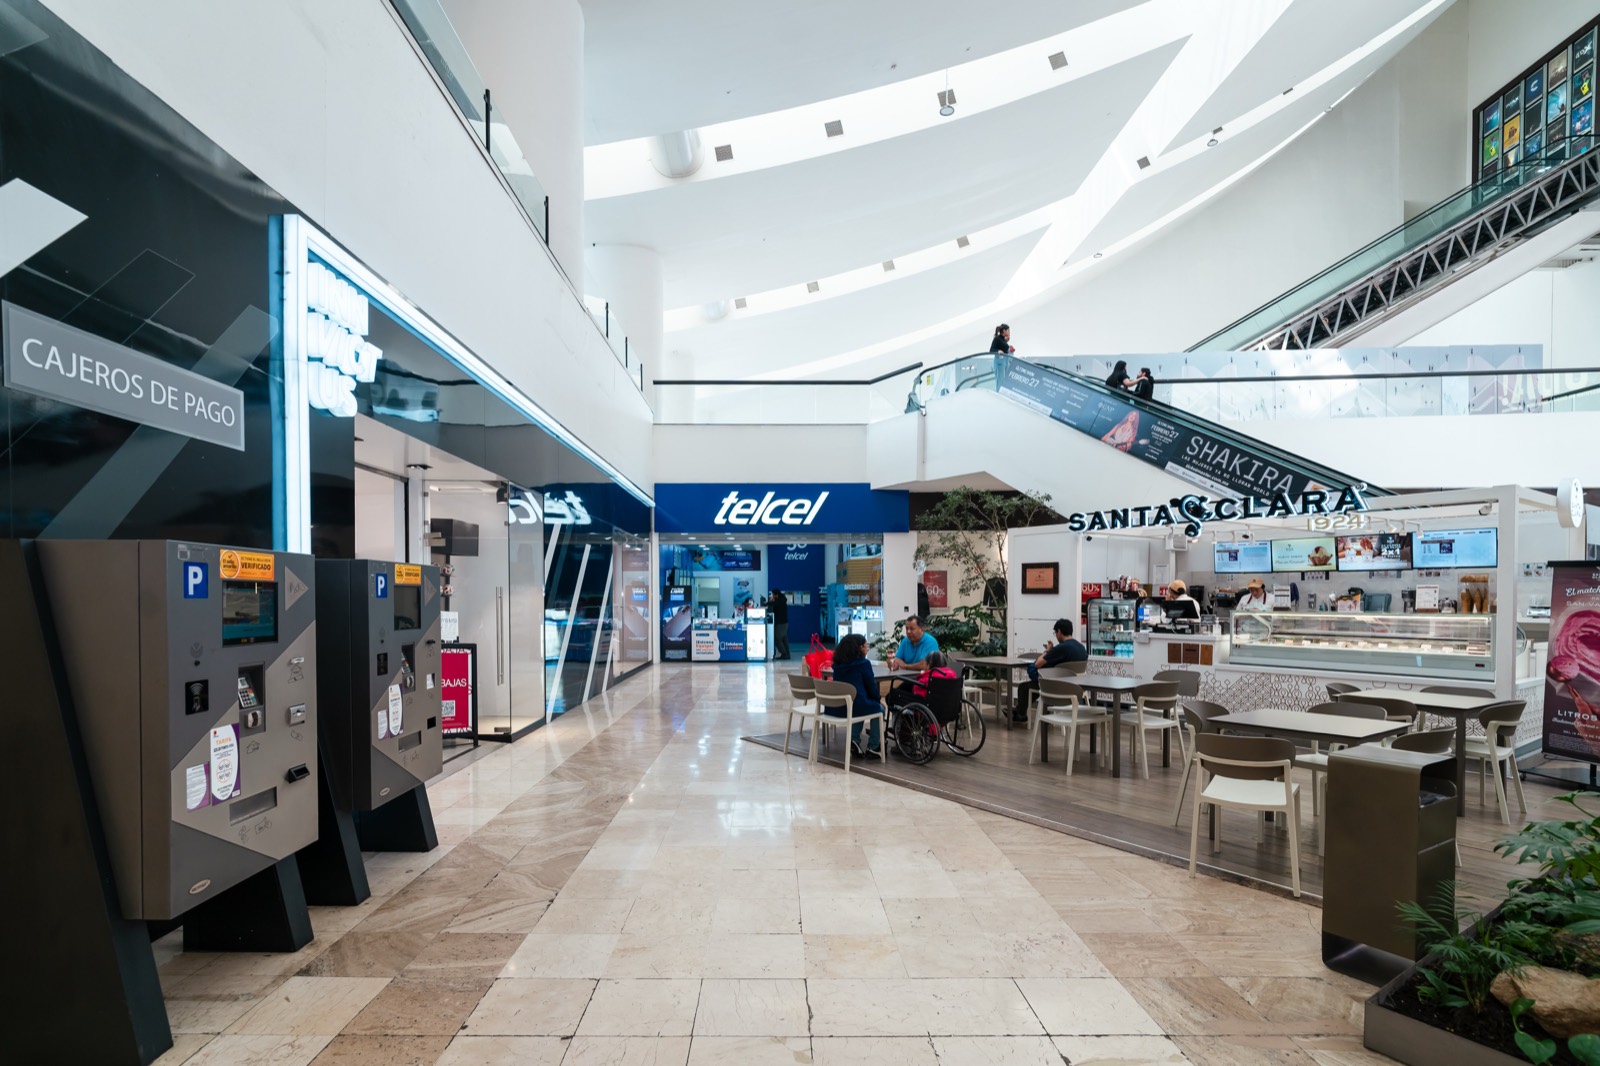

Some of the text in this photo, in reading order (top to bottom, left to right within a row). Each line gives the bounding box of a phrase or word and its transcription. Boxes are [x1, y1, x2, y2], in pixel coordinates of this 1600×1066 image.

[22, 338, 236, 427] CAJEROS DE PAGO
[1008, 371, 1031, 385] FEBRERO
[1029, 378, 1040, 388] 27
[1169, 430, 1179, 440] 27
[1186, 435, 1294, 494] SHAKIRA
[1181, 454, 1191, 462] LAS
[1192, 459, 1213, 472] MUJERES
[1232, 477, 1252, 489] LLORAN
[1252, 485, 1270, 498] WORLD
[713, 490, 830, 525] telcel
[1069, 485, 1368, 533] SANTA CLARA
[1306, 513, 1367, 532] 1924
[241, 561, 272, 571] VERIFICADO
[784, 552, 808, 561] telcel
[188, 566, 204, 596] P
[377, 575, 386, 597] P
[926, 584, 946, 597] 60%
[1566, 588, 1576, 597] El
[1557, 709, 1598, 722] LITROS
